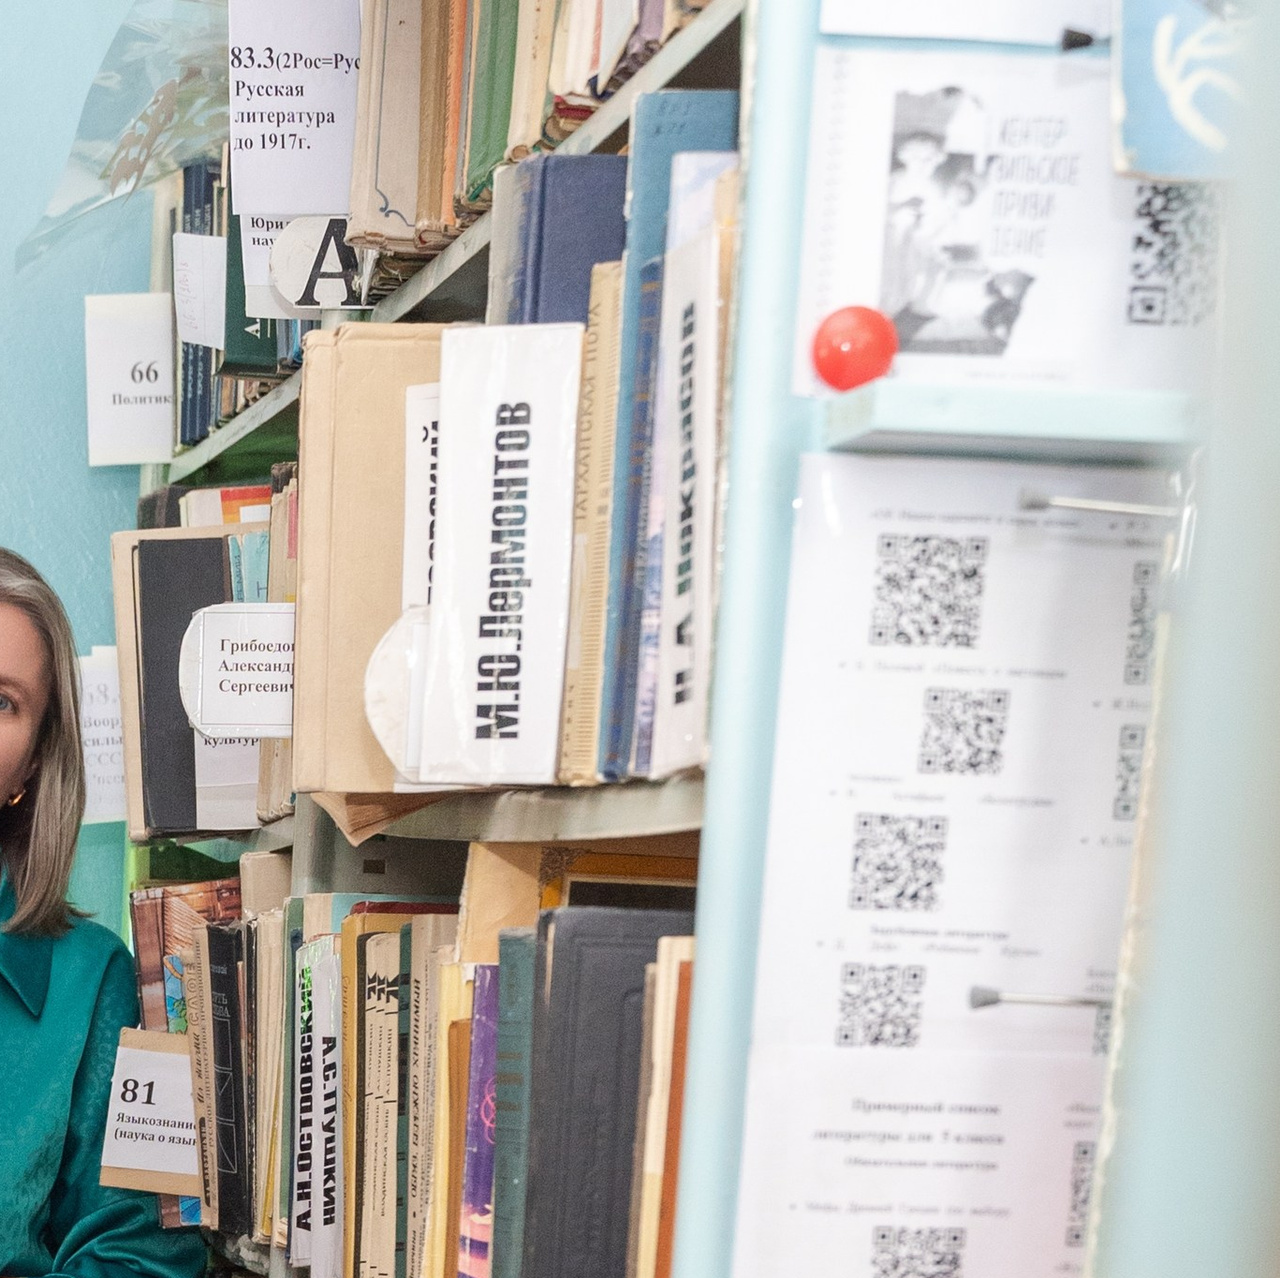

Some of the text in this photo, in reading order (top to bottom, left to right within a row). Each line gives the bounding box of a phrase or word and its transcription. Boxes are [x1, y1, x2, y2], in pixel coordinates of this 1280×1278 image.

[235, 80, 304, 98] Русская
[234, 109, 335, 127] литература
[234, 134, 311, 150] до 1917г.
[250, 217, 291, 231] Юри
[131, 361, 158, 384] 66
[475, 401, 531, 741] М.Ю.Лермонтов
[121, 1078, 156, 1106] 81
[114, 1128, 154, 1143] (наука
[159, 1135, 166, 1144] о
